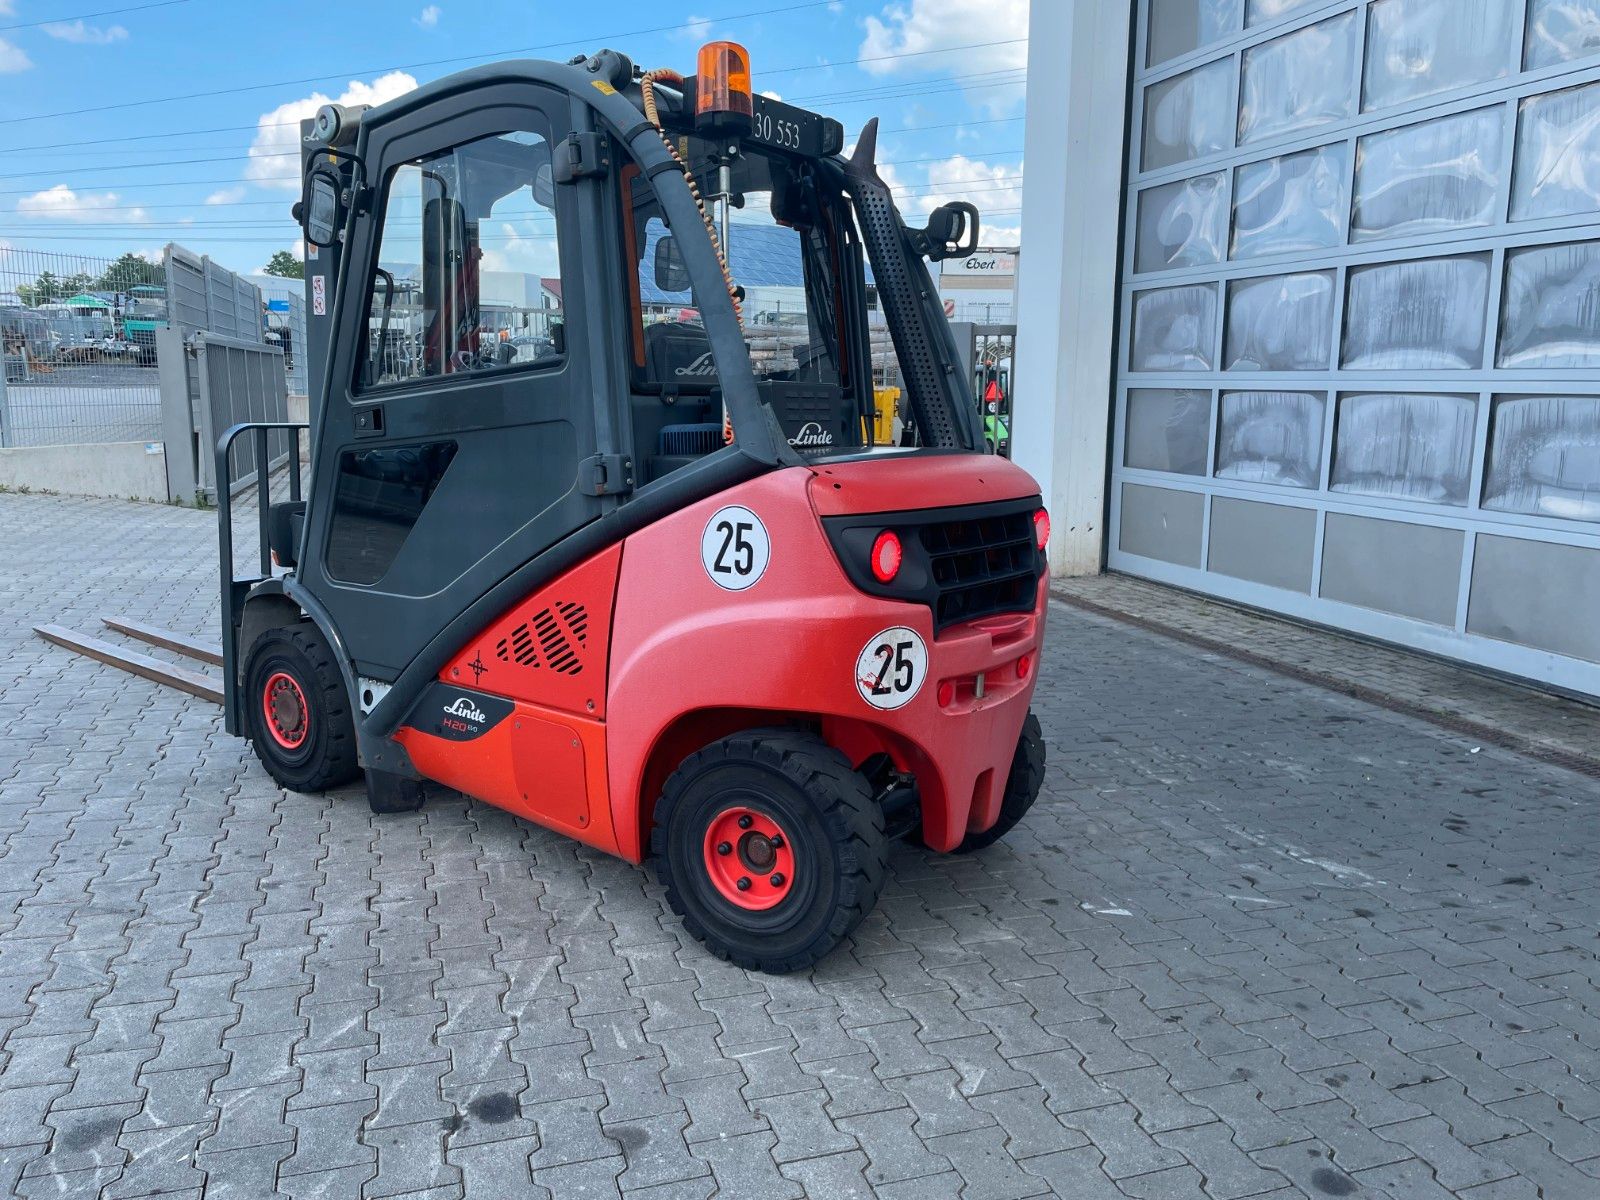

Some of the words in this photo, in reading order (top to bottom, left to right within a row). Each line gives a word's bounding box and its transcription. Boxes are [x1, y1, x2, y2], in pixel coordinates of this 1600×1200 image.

[755, 112, 772, 141] 30
[776, 119, 800, 149] 553
[966, 257, 996, 270] Ebert
[674, 351, 719, 376] Lin
[787, 422, 833, 446] Linde
[713, 520, 754, 576] 25
[871, 640, 914, 696] 25
[443, 697, 486, 724] Linde
[443, 717, 468, 733] H20
